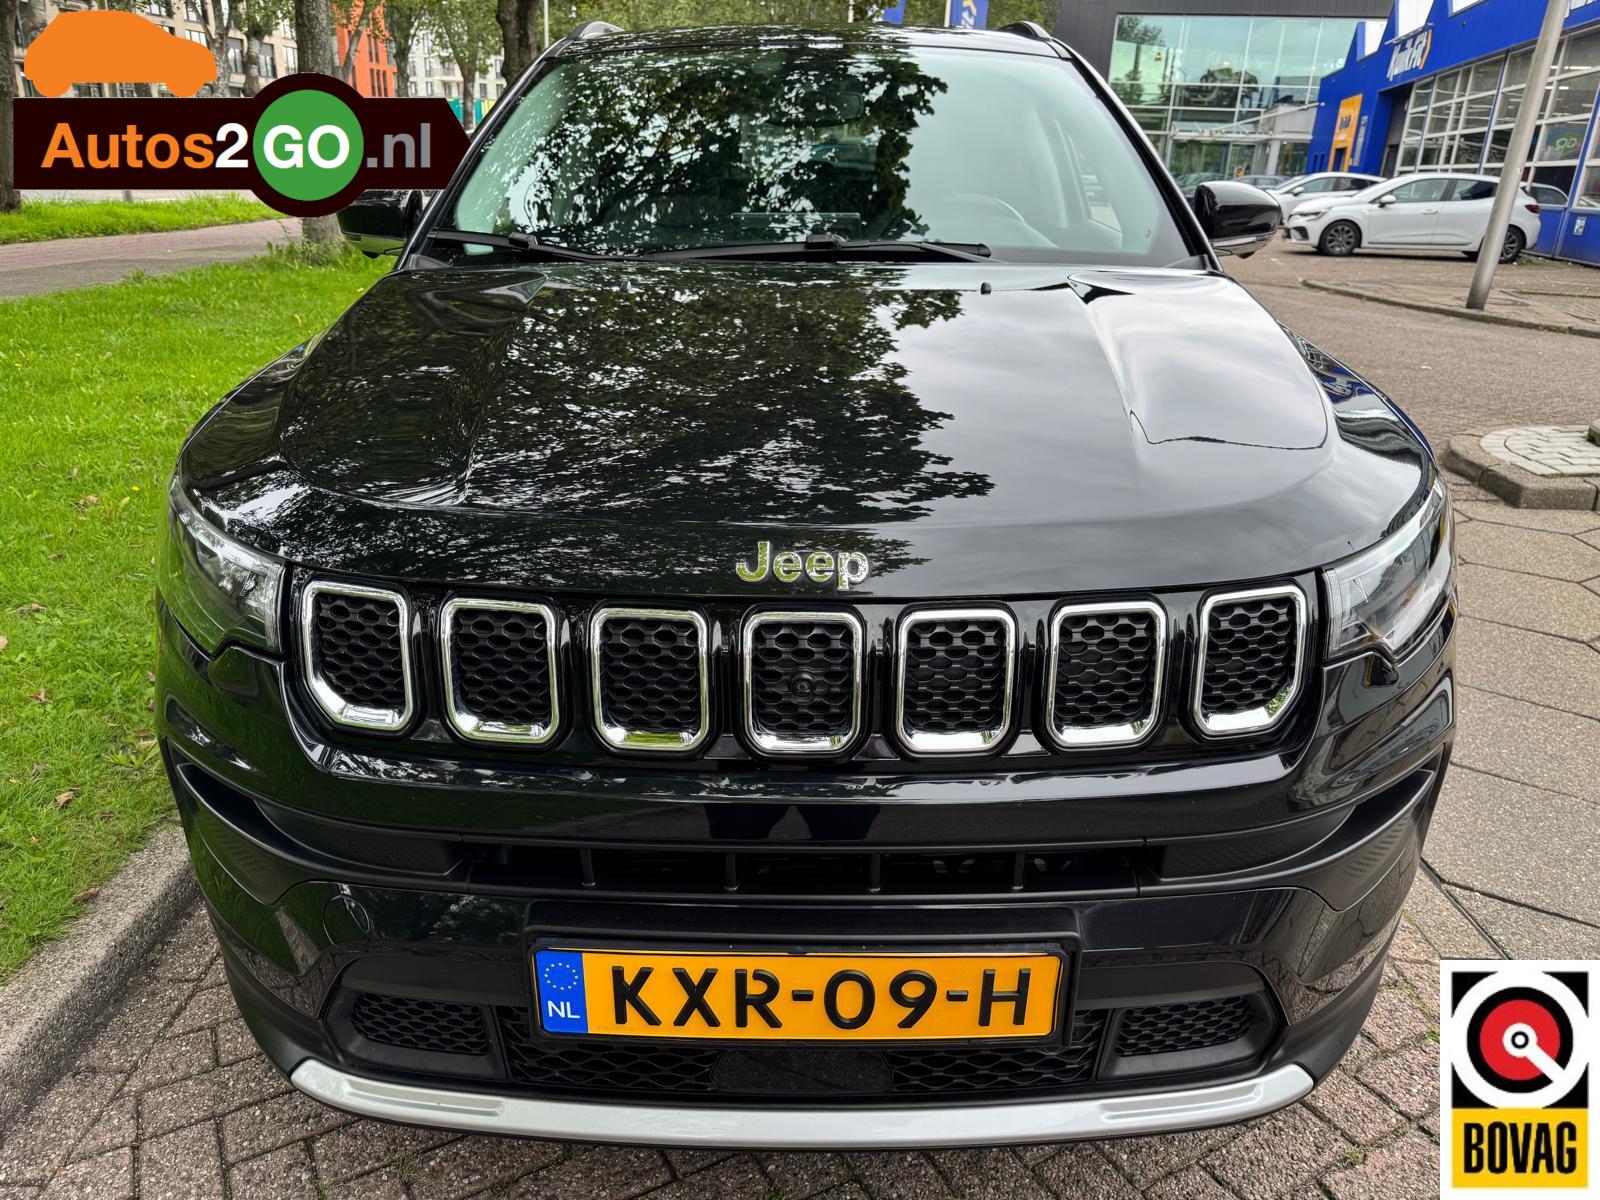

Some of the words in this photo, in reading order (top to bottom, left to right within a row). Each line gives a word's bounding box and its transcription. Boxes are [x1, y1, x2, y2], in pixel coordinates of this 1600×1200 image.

[735, 541, 869, 591] Jeep
[547, 1000, 580, 1019] NL
[611, 966, 1032, 1030] KXR-09-H
